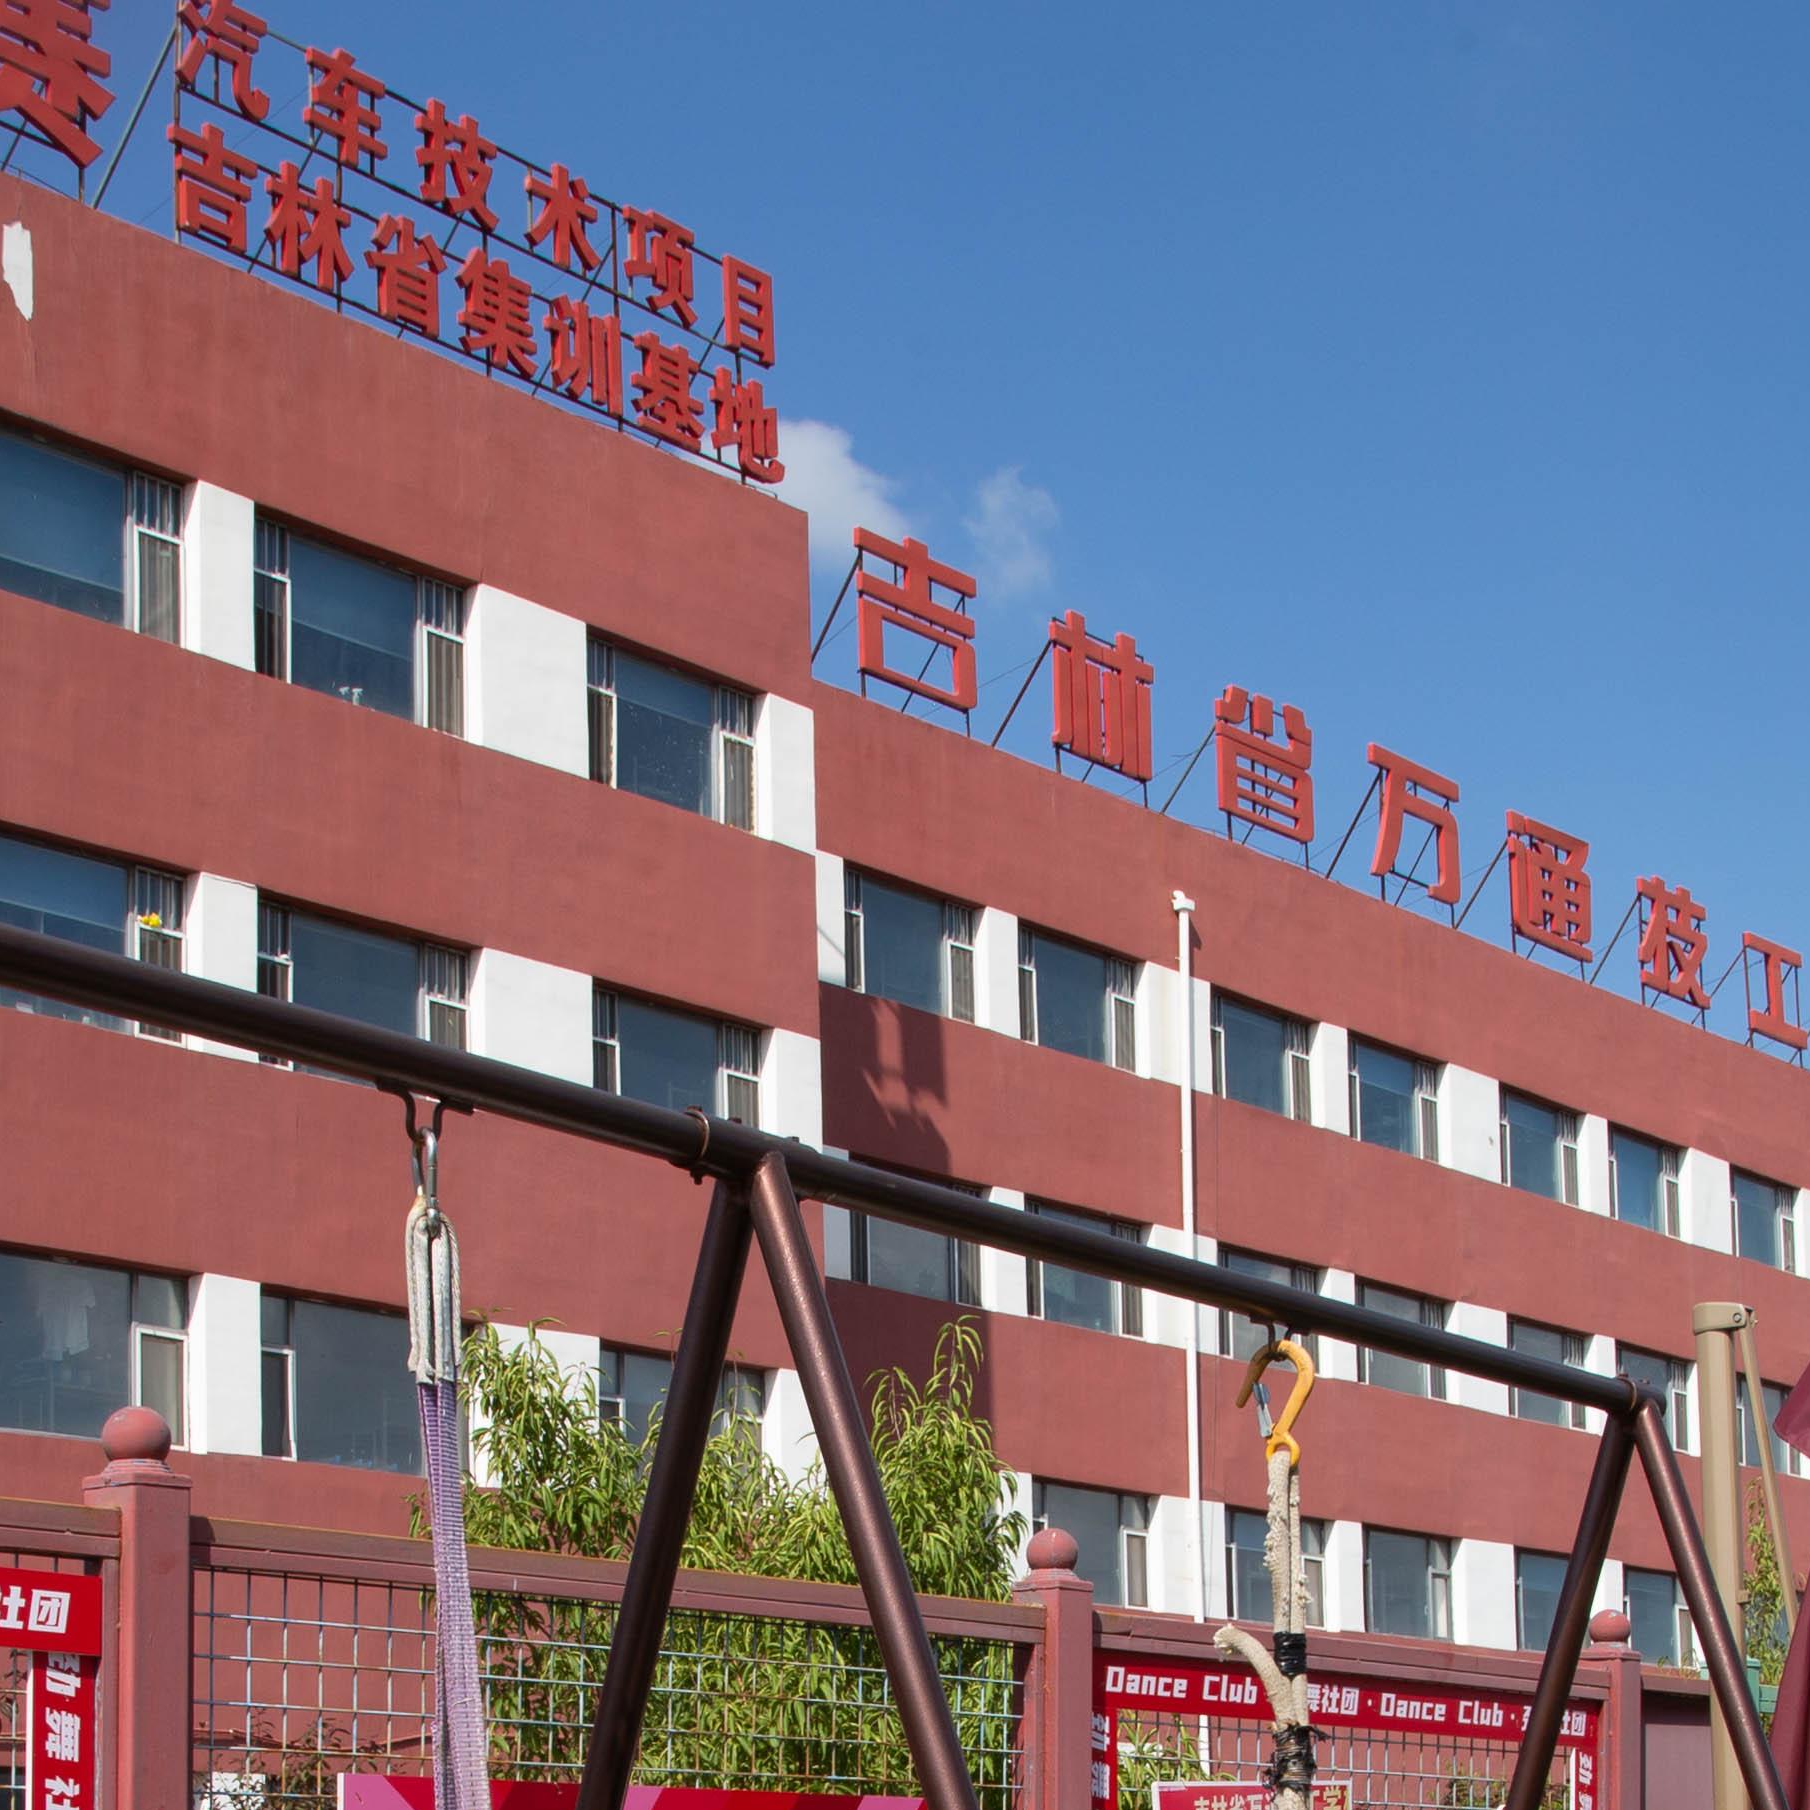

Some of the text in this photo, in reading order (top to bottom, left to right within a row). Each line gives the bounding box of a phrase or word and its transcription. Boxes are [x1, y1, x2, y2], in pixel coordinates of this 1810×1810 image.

[168, 122, 786, 484] 吉林省集训基地
[178, 0, 777, 368] 汽车技术项目
[1106, 1665, 1187, 1698] Dance
[1203, 1675, 1257, 1705] Club
[1380, 1693, 1445, 1723] Dance
[1458, 1700, 1503, 1728] Club
